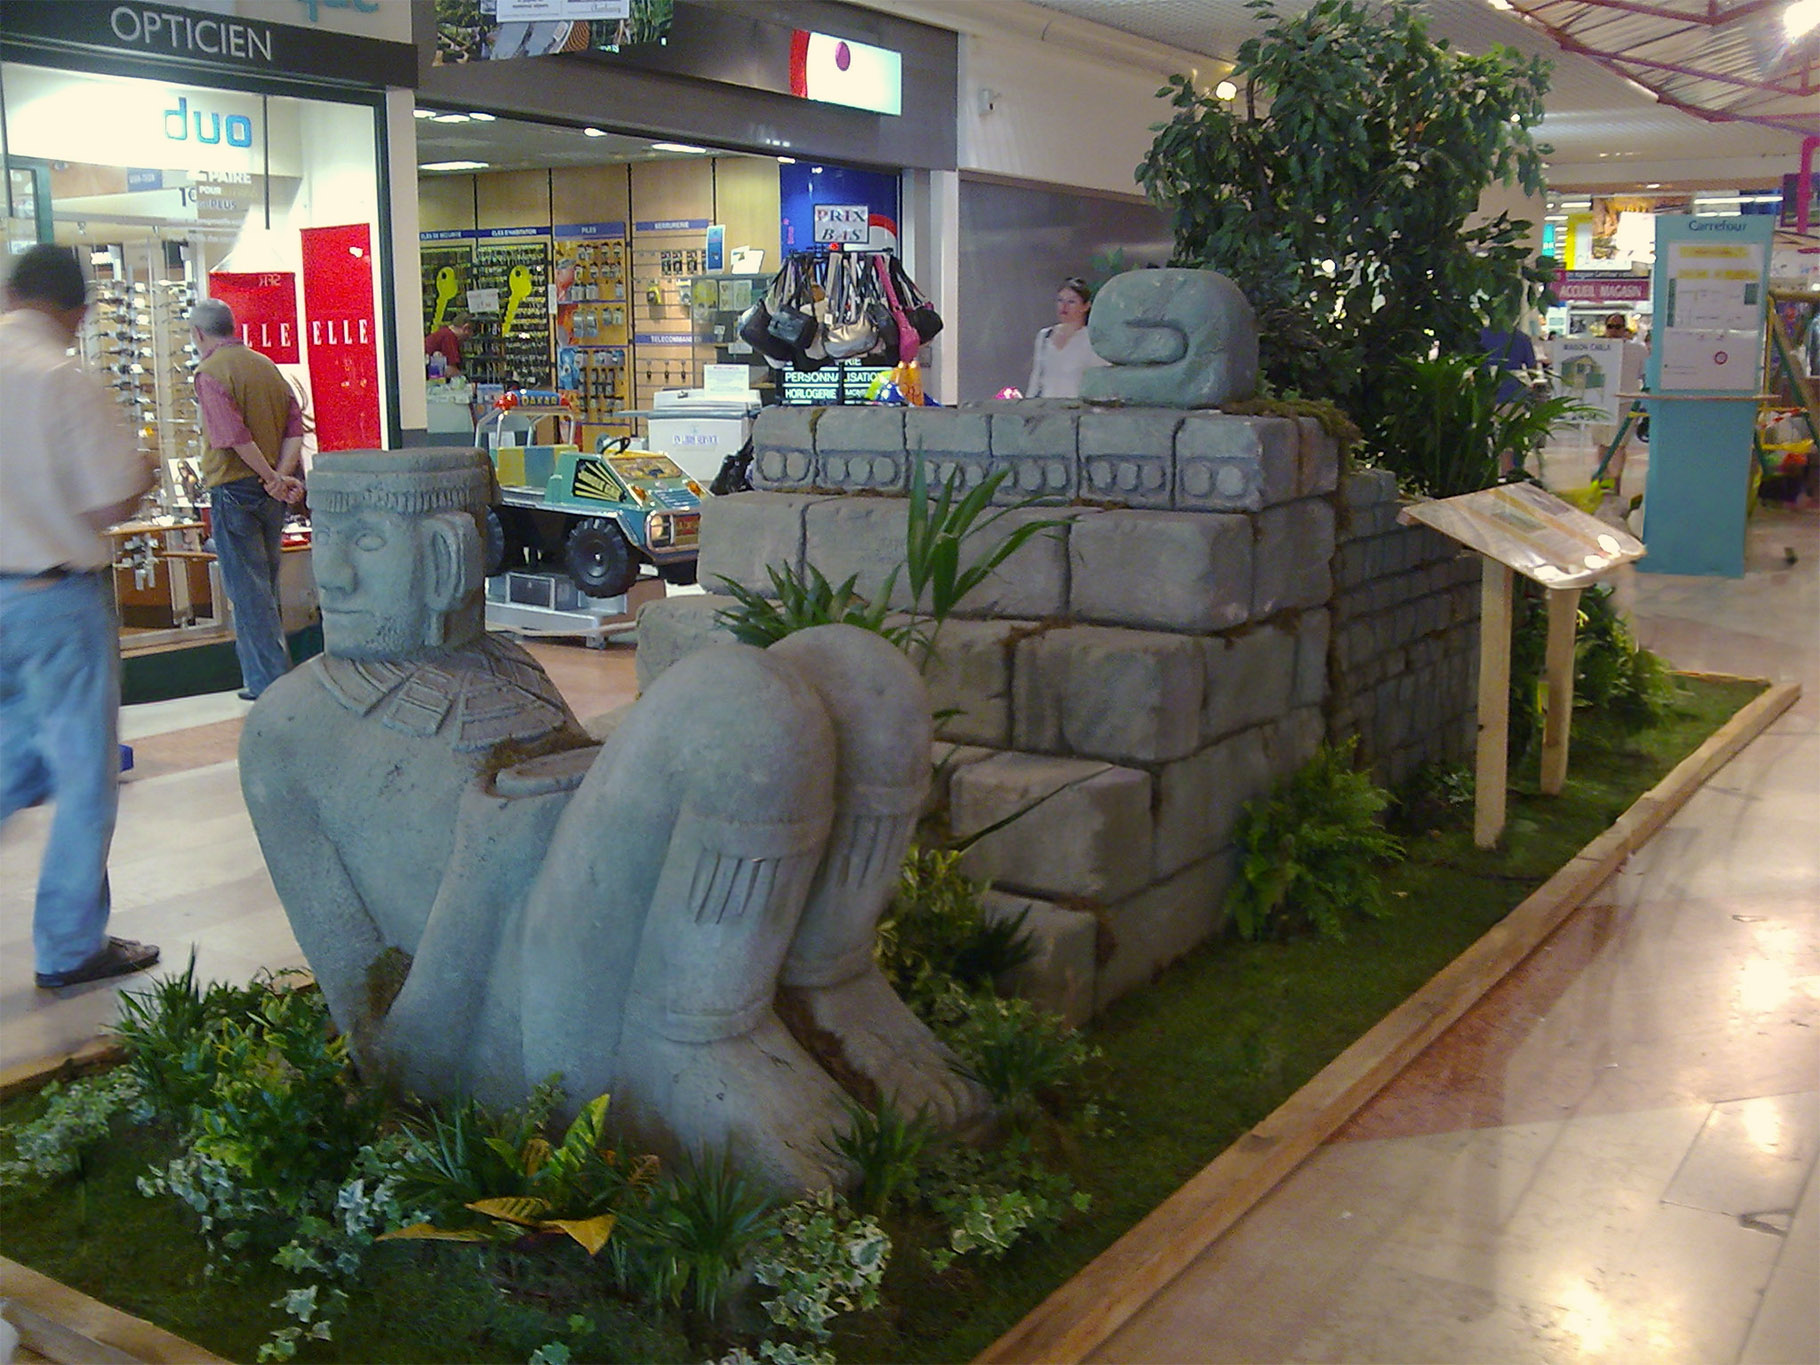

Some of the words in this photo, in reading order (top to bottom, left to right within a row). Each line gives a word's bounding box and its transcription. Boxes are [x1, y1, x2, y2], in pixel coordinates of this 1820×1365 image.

[110, 6, 273, 61] OPTICIEN
[163, 97, 252, 148] duo
[817, 209, 865, 223] PRIX
[1688, 219, 1748, 232] Carrefour
[822, 228, 862, 241] BAS
[242, 323, 291, 347] LLE
[312, 319, 368, 345] ELLE
[785, 388, 837, 399] HORLOGERIE
